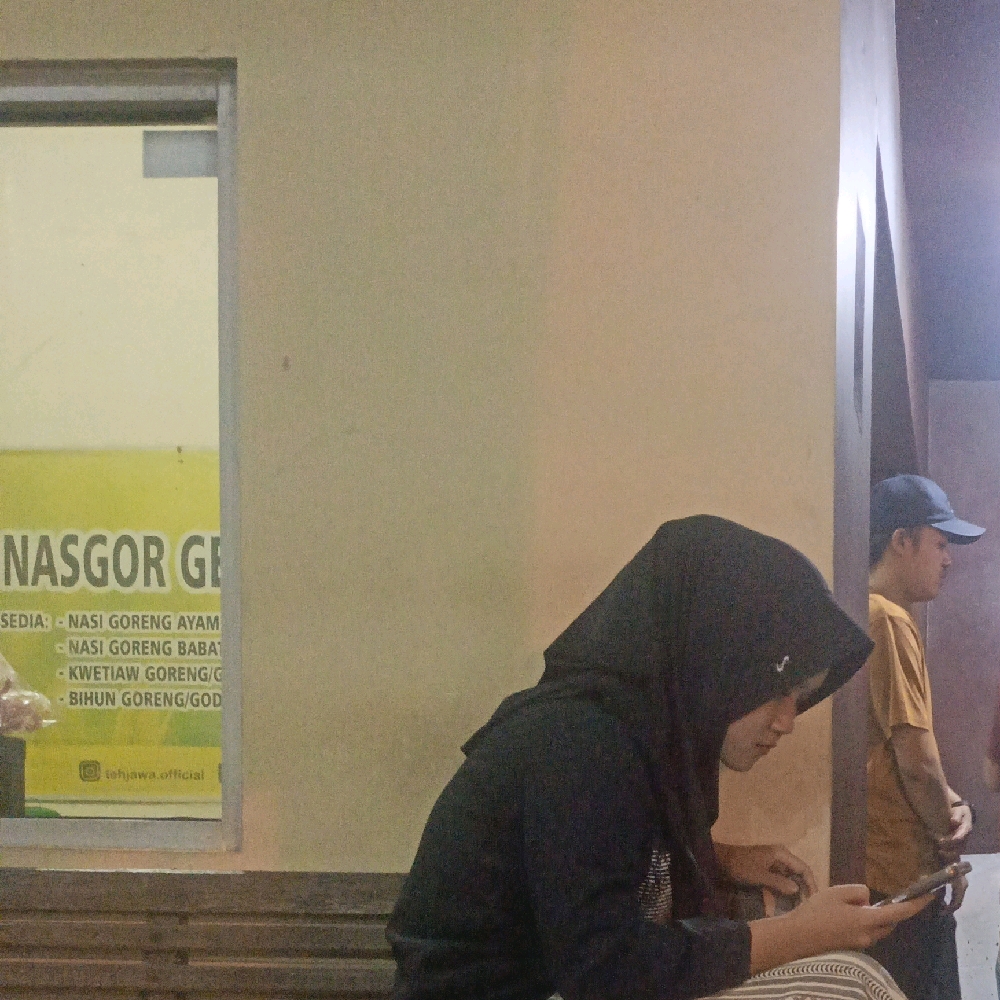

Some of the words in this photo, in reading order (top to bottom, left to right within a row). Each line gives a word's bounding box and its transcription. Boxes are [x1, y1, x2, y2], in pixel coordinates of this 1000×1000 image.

[4, 533, 167, 588] NASGOR
[0, 613, 48, 629] SEDIA:
[68, 613, 103, 629] NASI
[109, 614, 172, 630] GORENG
[177, 615, 220, 631] AYAM
[68, 640, 103, 655] NASI
[109, 640, 172, 656] GORENG
[68, 665, 139, 681] KWETIAW
[69, 691, 116, 707] BIHUN
